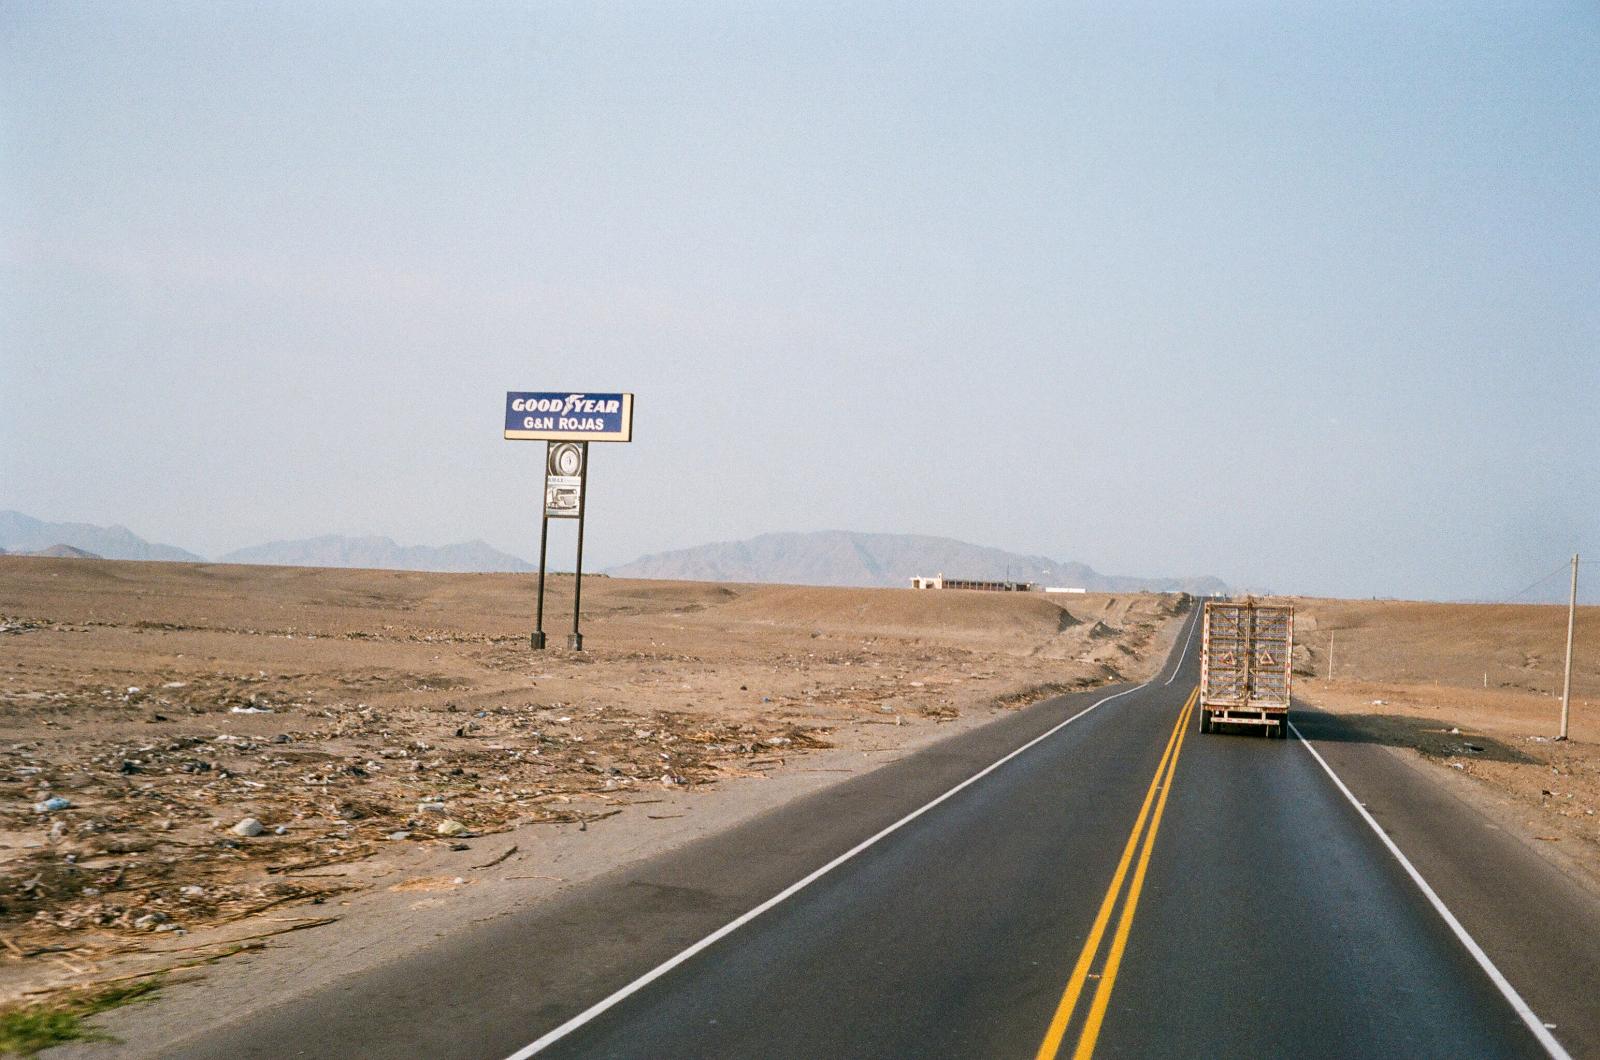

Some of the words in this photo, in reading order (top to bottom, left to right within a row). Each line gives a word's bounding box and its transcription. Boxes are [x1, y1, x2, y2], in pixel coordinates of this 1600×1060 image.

[511, 396, 620, 415] GOODYEAR
[523, 417, 554, 429] G&N
[558, 418, 604, 430] ROJAS
